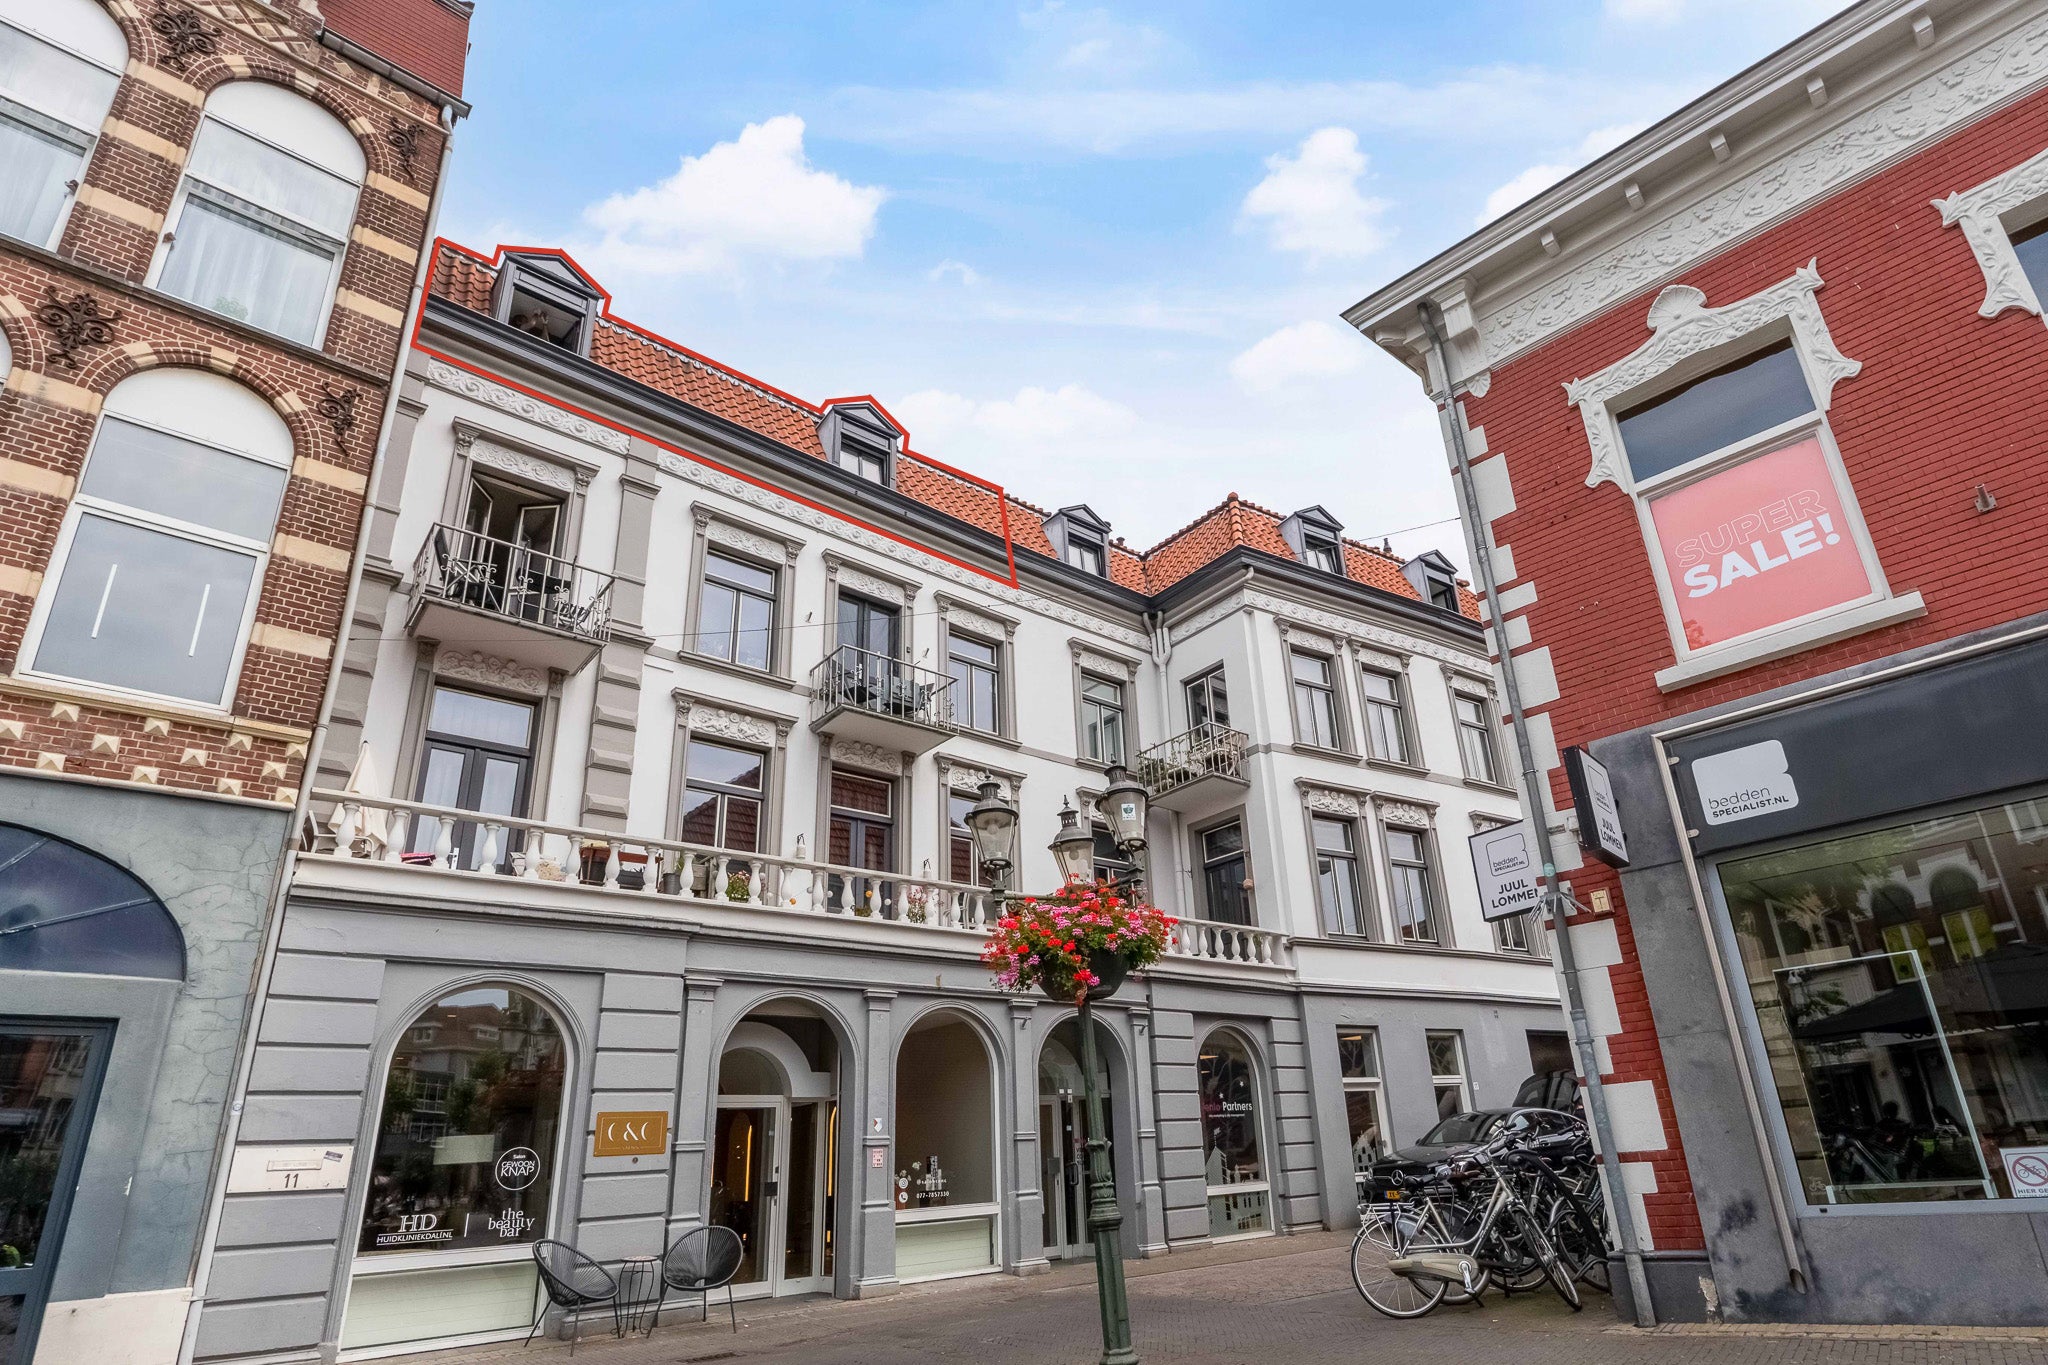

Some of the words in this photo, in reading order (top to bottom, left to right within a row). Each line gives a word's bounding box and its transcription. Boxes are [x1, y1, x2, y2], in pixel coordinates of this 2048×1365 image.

[1675, 489, 1827, 568] SUPER
[1683, 512, 1841, 598] SALE!
[1708, 787, 1771, 809] bedden
[1712, 795, 1790, 818] SPECIALIST.NL
[1492, 856, 1519, 868] bedden
[1498, 878, 1529, 895] JUUL
[1222, 1101, 1253, 1111] Partners
[501, 1160, 536, 1168] GEWOON
[500, 1166, 535, 1177] KNAP
[284, 1173, 299, 1188] 11
[502, 1208, 524, 1220] the
[398, 1213, 437, 1232] HD
[488, 1217, 536, 1231] beauty
[500, 1226, 522, 1238] bar
